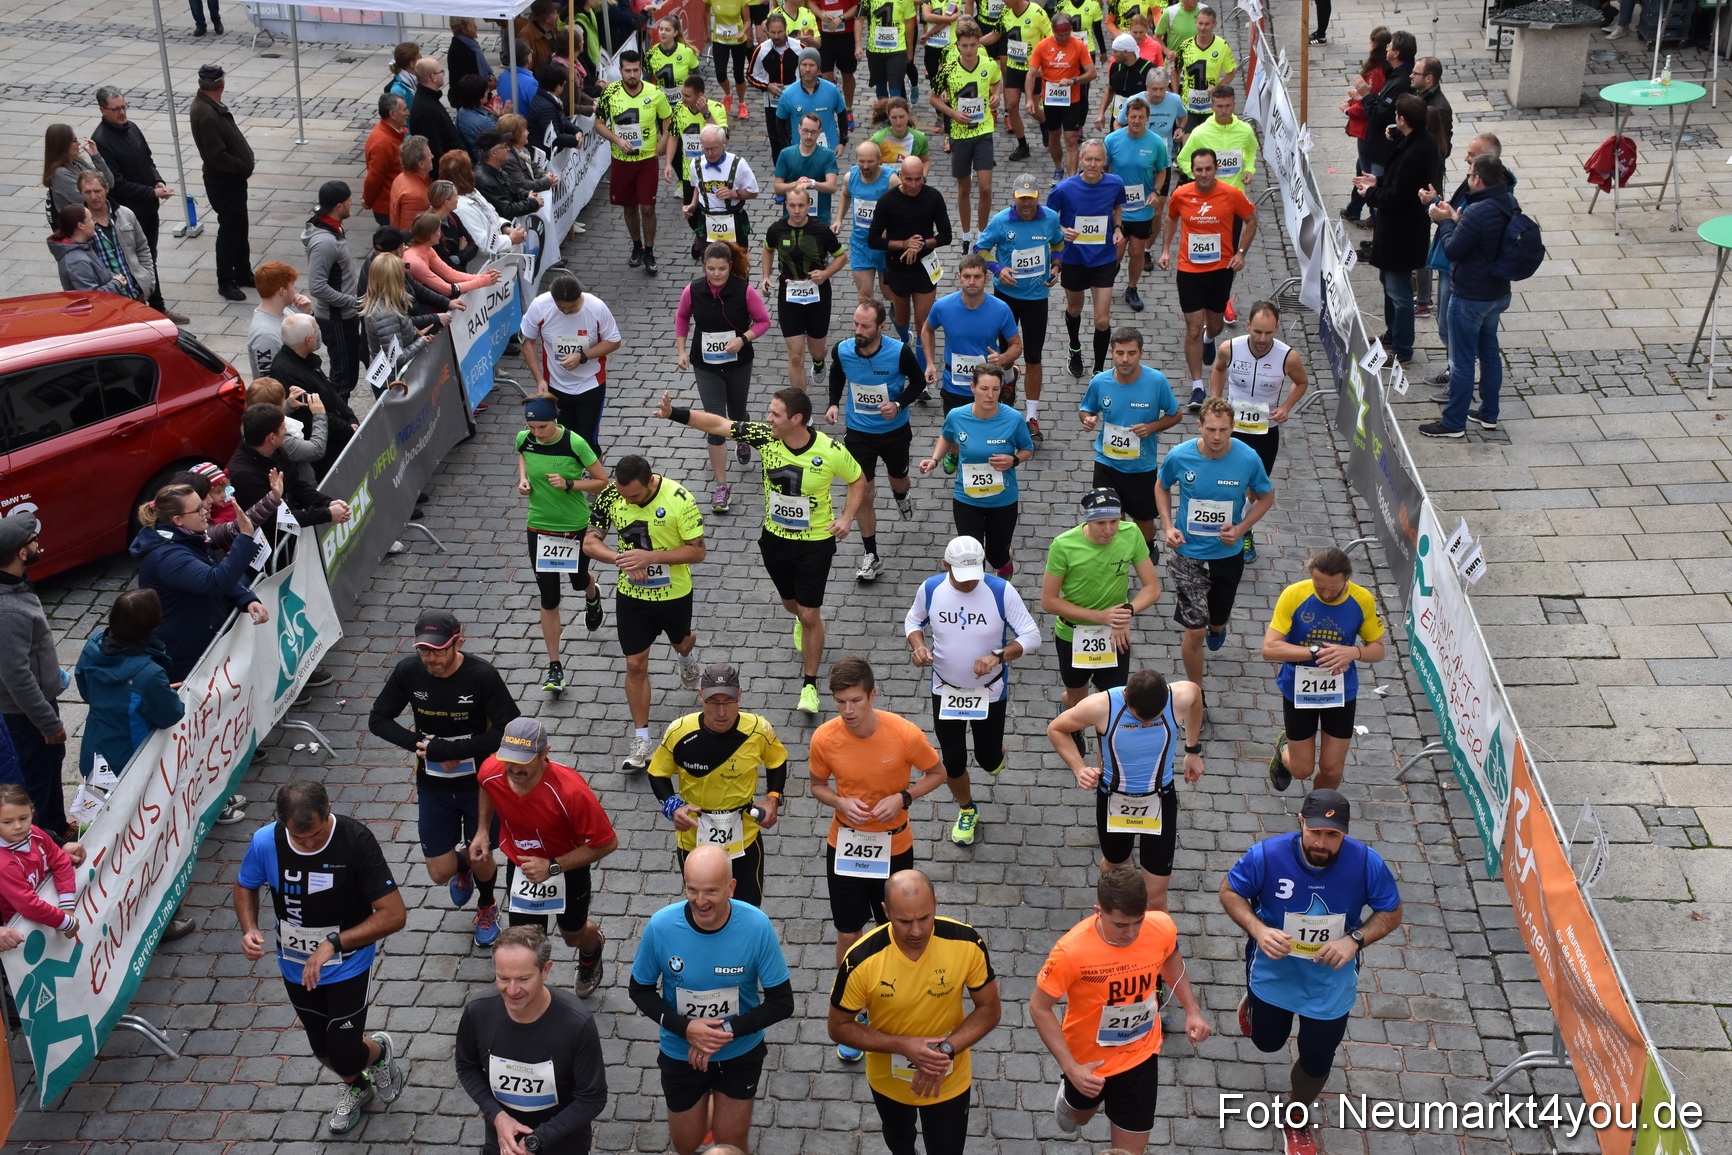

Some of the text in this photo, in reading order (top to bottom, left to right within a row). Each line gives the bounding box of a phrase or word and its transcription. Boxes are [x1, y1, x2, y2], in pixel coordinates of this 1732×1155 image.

[877, 33, 895, 42] 2685
[1048, 89, 1067, 97] 2490
[1191, 95, 1210, 104] 2689
[962, 104, 982, 114] 2674
[618, 132, 638, 141] 2668
[1216, 157, 1237, 167] 2468
[1126, 193, 1140, 202] 454
[857, 207, 873, 218] 257
[712, 223, 728, 233] 220
[1082, 225, 1100, 234] 304
[1192, 242, 1215, 253] 2641
[1016, 255, 1041, 268] 2513
[790, 287, 814, 297] 2254
[557, 344, 584, 354] 2073
[956, 363, 975, 374] 244
[857, 392, 884, 404] 2653
[1239, 410, 1260, 422] 110
[985, 438, 1007, 446] BOCK
[1110, 434, 1131, 448] 254
[971, 472, 994, 487] 253
[1217, 478, 1241, 487] BOCK
[1, 495, 19, 508] BMW
[774, 503, 804, 518] 2659
[1193, 509, 1226, 524] 2595
[543, 545, 574, 558] 2477
[646, 564, 664, 577] 64
[1465, 556, 1481, 577] swn
[939, 608, 987, 629] SUSPA
[1081, 637, 1106, 653] 236
[1302, 678, 1337, 693] 2144
[947, 695, 982, 709] 2057
[1303, 695, 1336, 703] Hans-Jürgen
[505, 736, 532, 747] BOMAG
[683, 761, 709, 771] Steffen
[1120, 804, 1149, 816] 277
[709, 827, 733, 844] 234
[843, 841, 884, 859] 2457
[855, 861, 870, 869] Peter
[519, 880, 558, 899] 2449
[1275, 878, 1296, 900] 3
[1298, 927, 1331, 943] 178
[288, 935, 321, 952] 213
[714, 965, 745, 975] BOCK
[934, 967, 948, 975] TSV
[1080, 968, 1098, 976] URBAN
[1116, 964, 1131, 973] VIBES
[1108, 972, 1152, 1001] RUN
[685, 1000, 731, 1019] 2734
[1107, 1010, 1151, 1029] 2124
[498, 1074, 545, 1094] 2737
